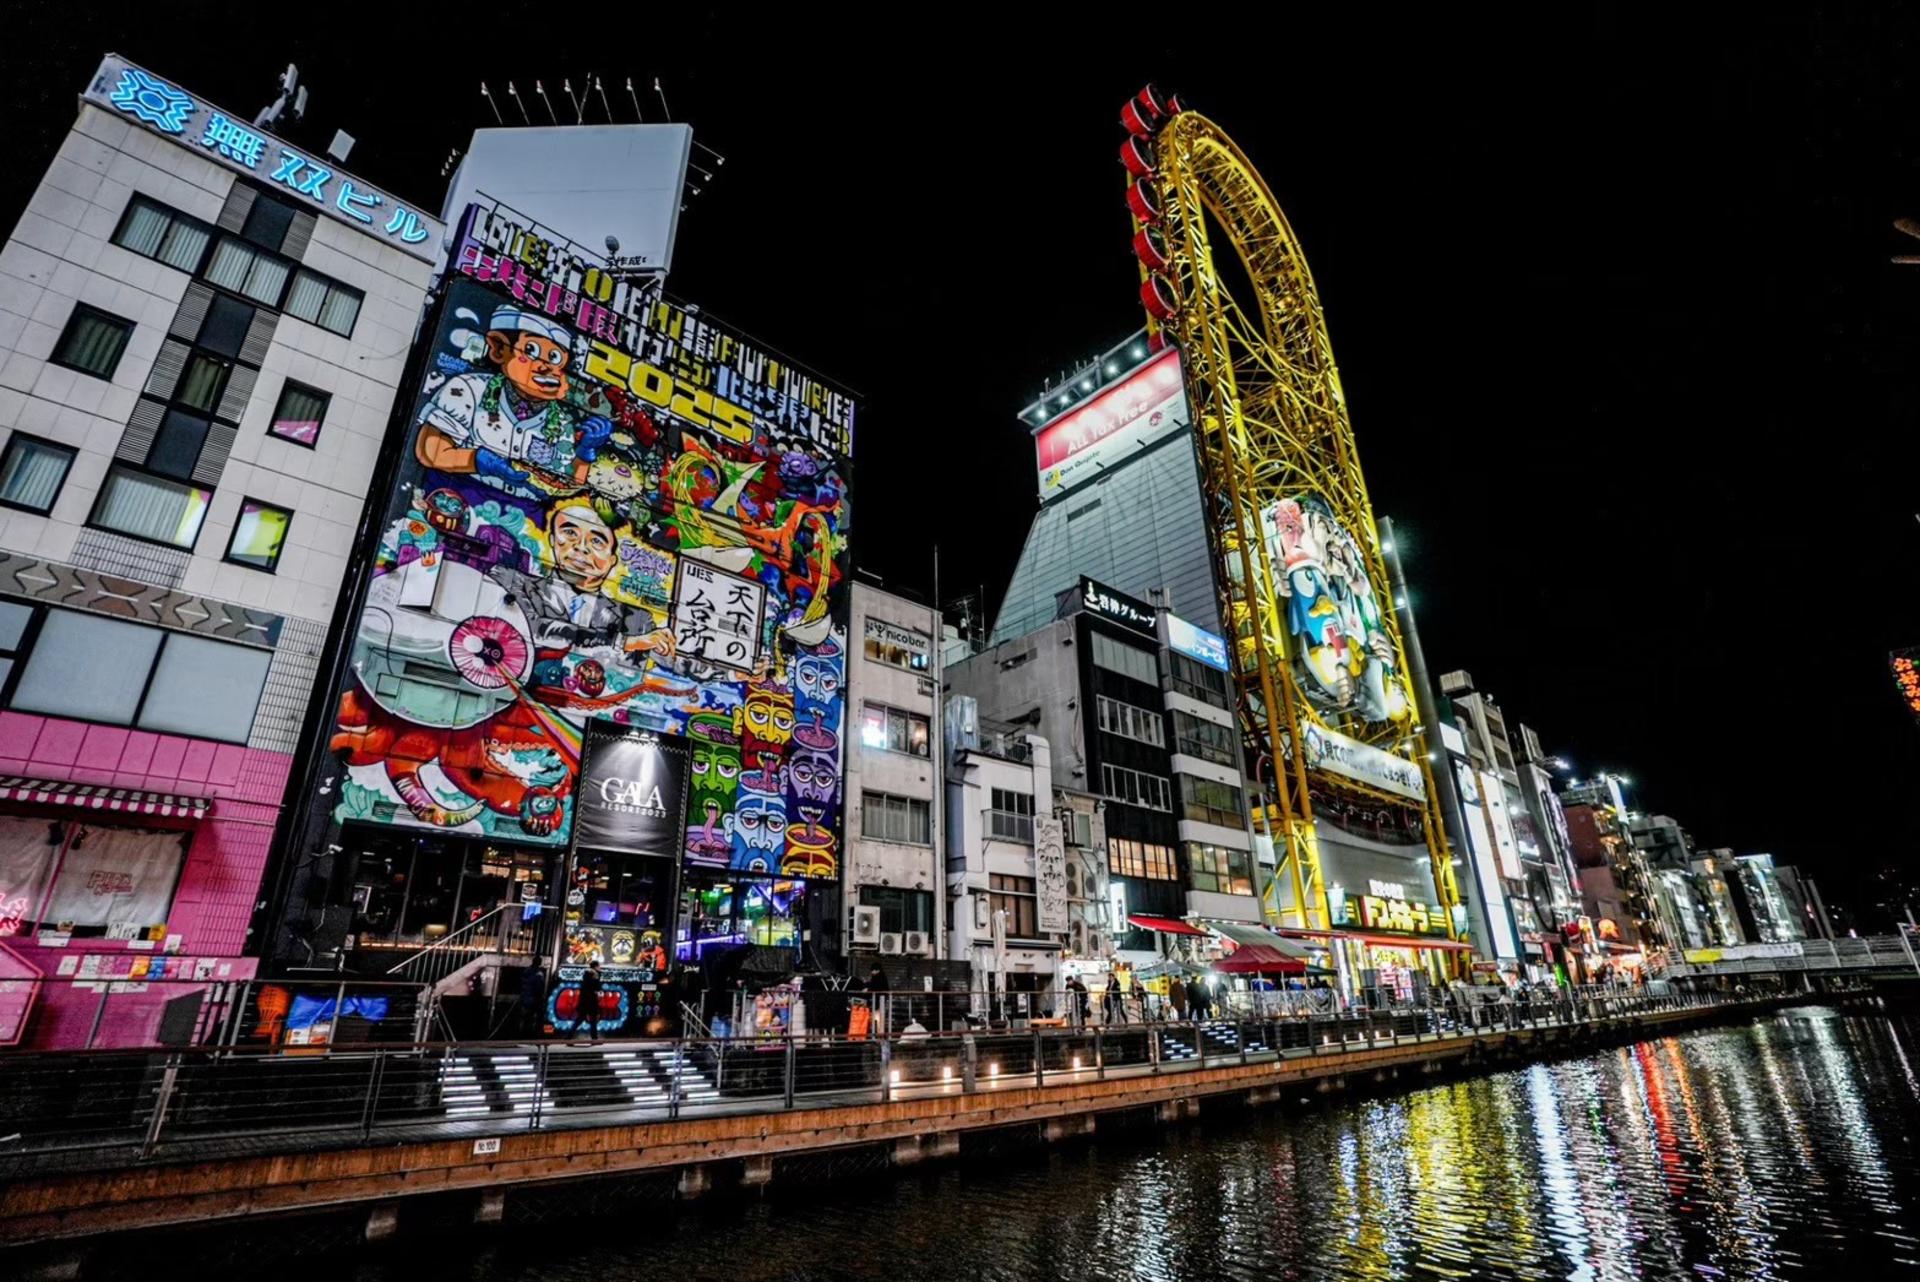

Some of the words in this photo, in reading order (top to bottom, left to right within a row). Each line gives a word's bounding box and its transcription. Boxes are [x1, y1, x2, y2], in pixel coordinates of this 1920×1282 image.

[200, 111, 430, 244] 無双ビル
[584, 339, 755, 445] 2025
[714, 333, 851, 426] FUTURE
[678, 588, 716, 656] 台所
[725, 583, 756, 661] 天下の
[600, 776, 667, 811] GALA
